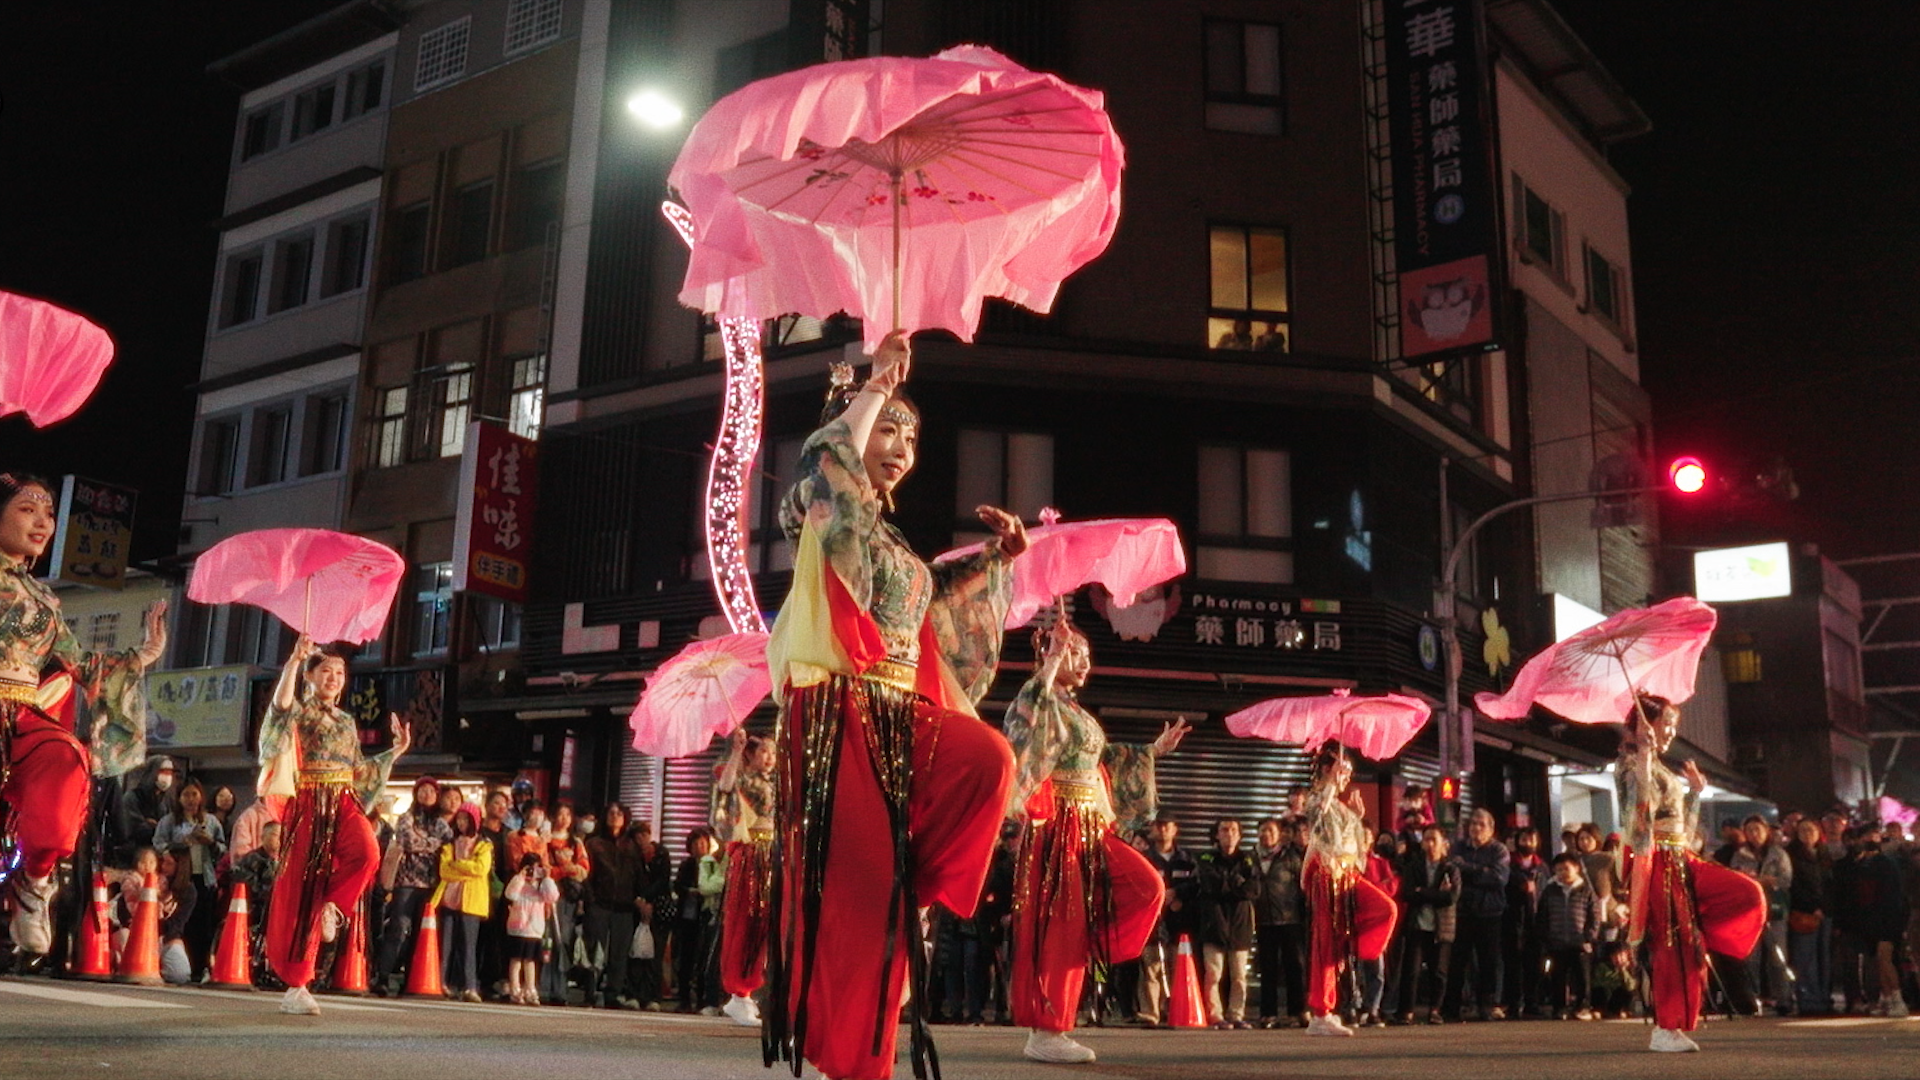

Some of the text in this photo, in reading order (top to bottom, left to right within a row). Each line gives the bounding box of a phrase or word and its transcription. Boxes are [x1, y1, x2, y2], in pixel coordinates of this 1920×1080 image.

[1403, 0, 1455, 57] 華
[1428, 61, 1462, 191] 藥師藥局
[1414, 153, 1429, 256] PHARMACY
[483, 442, 522, 551] 佳味
[477, 554, 520, 586] 伴手禮
[1192, 594, 1292, 615] Pharmacy
[1195, 615, 1341, 651] 藥師藥局
